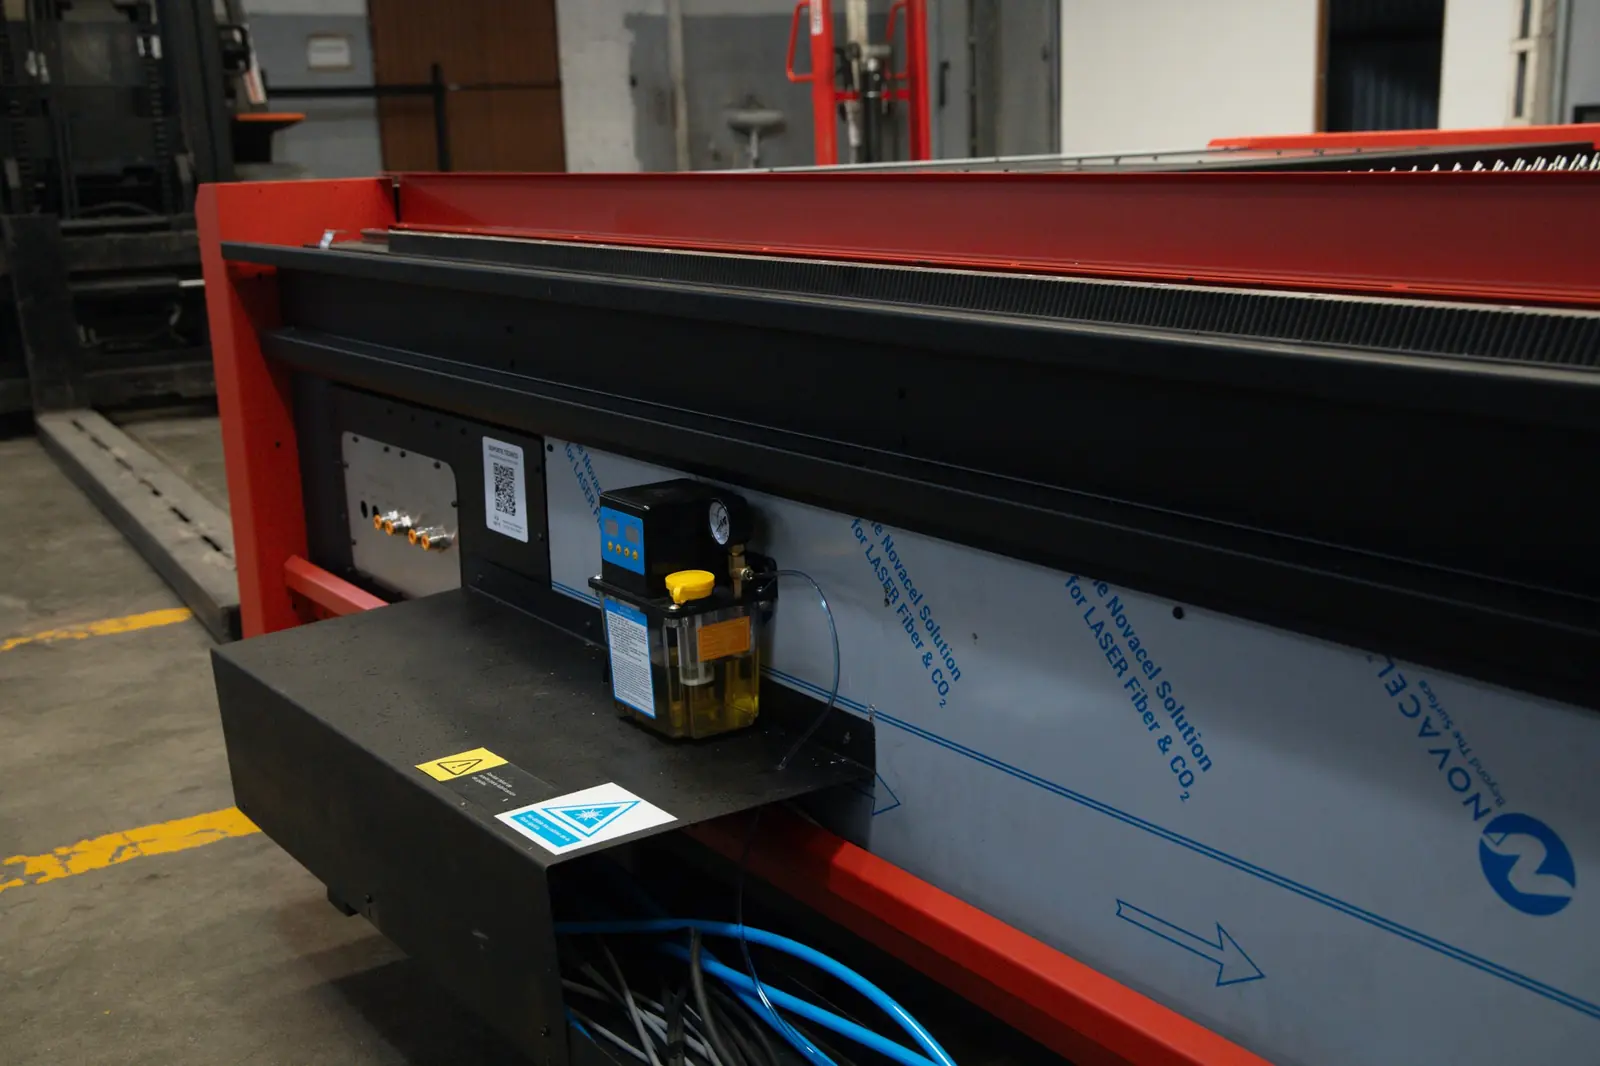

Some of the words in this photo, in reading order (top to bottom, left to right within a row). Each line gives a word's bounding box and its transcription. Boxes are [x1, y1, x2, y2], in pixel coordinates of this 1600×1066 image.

[574, 462, 595, 508] LASER
[583, 452, 602, 497] Novac
[850, 518, 868, 545] for
[865, 544, 900, 605] LASER
[896, 603, 924, 650] Fiber
[922, 651, 933, 670] &
[881, 534, 924, 606] Novacel
[919, 605, 962, 682] Solution
[1065, 575, 1087, 606] for
[1083, 606, 1129, 678] LASER
[1123, 676, 1160, 731] Fiber
[1157, 734, 1173, 755] &
[1106, 595, 1162, 680] Novacel
[1156, 680, 1212, 772] Solution
[1418, 679, 1454, 731] Surface
[1377, 656, 1492, 821] NOVACEL
[1453, 730, 1473, 758] The
[1469, 757, 1506, 808] Beyond
